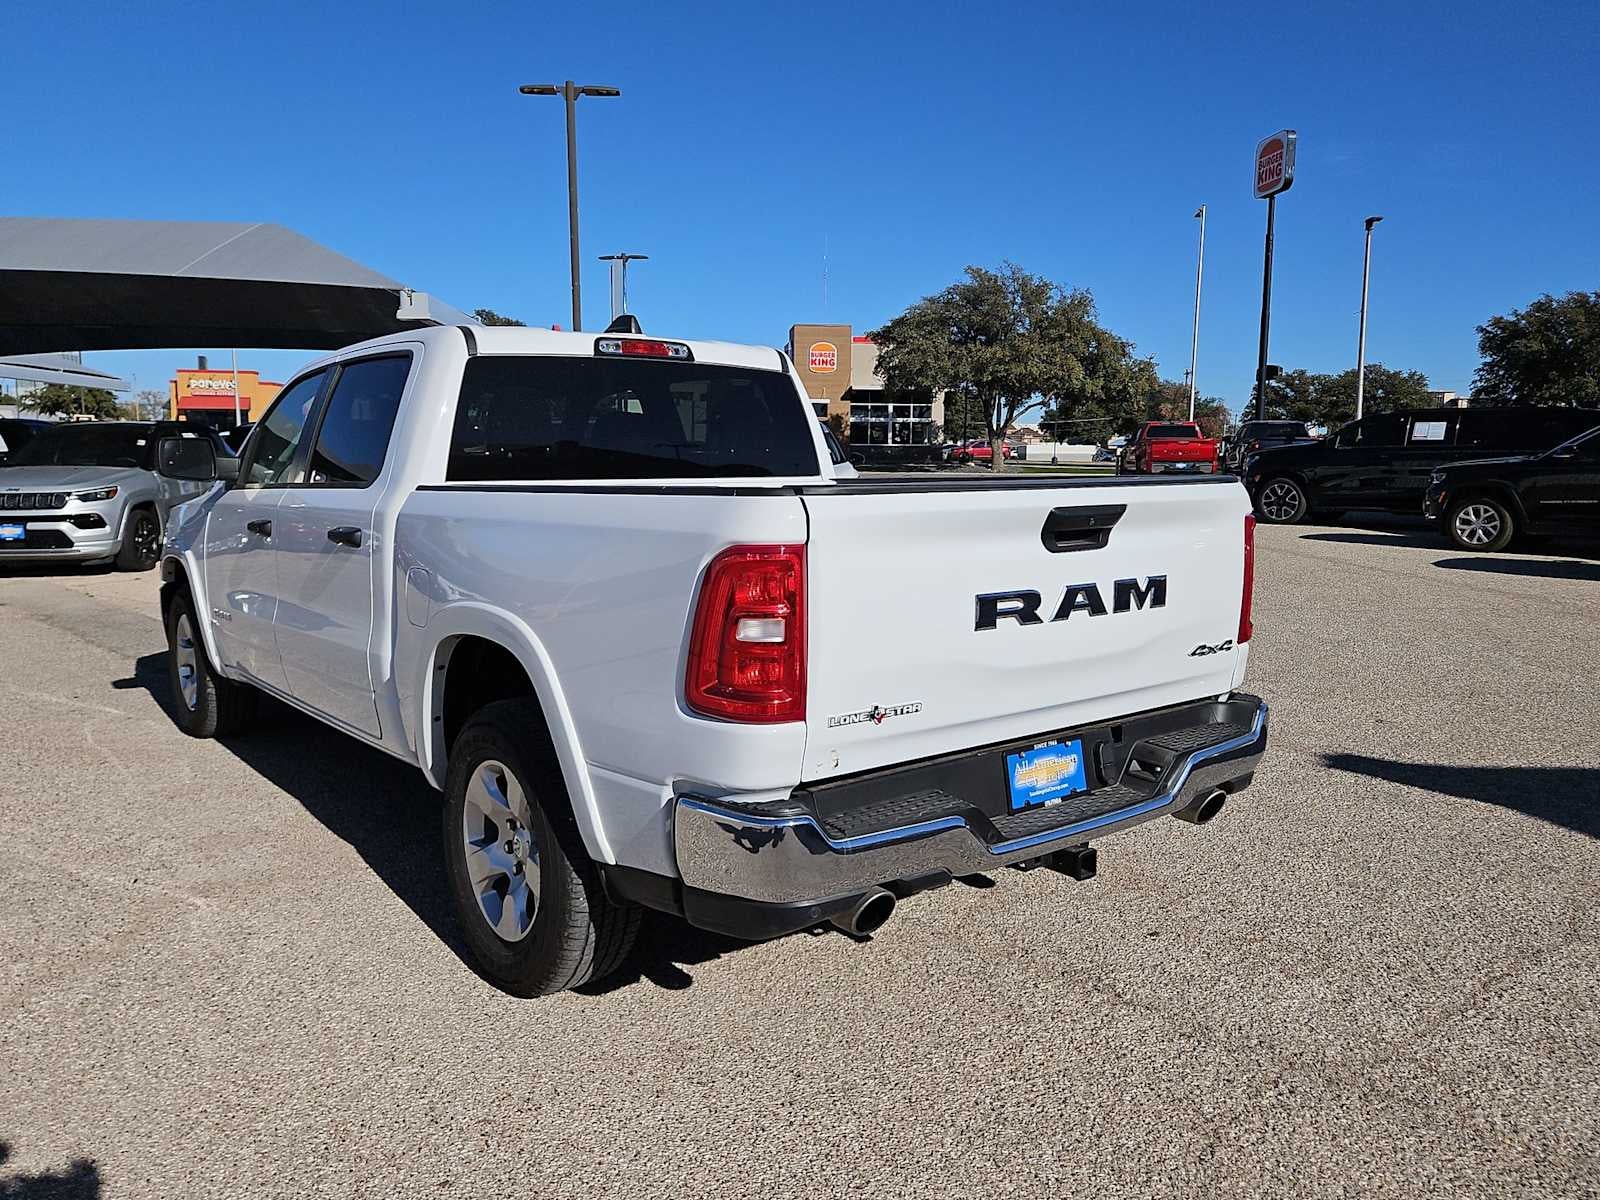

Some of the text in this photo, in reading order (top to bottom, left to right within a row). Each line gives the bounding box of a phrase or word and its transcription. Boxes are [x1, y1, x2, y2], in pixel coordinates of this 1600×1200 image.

[1258, 152, 1283, 171] BURGER
[1257, 162, 1282, 186] KING
[810, 358, 836, 367] KING
[974, 574, 1167, 632] RAM
[1188, 639, 1233, 657] 4x4
[828, 702, 922, 728] LONE STAR
[1015, 753, 1078, 775] All American
